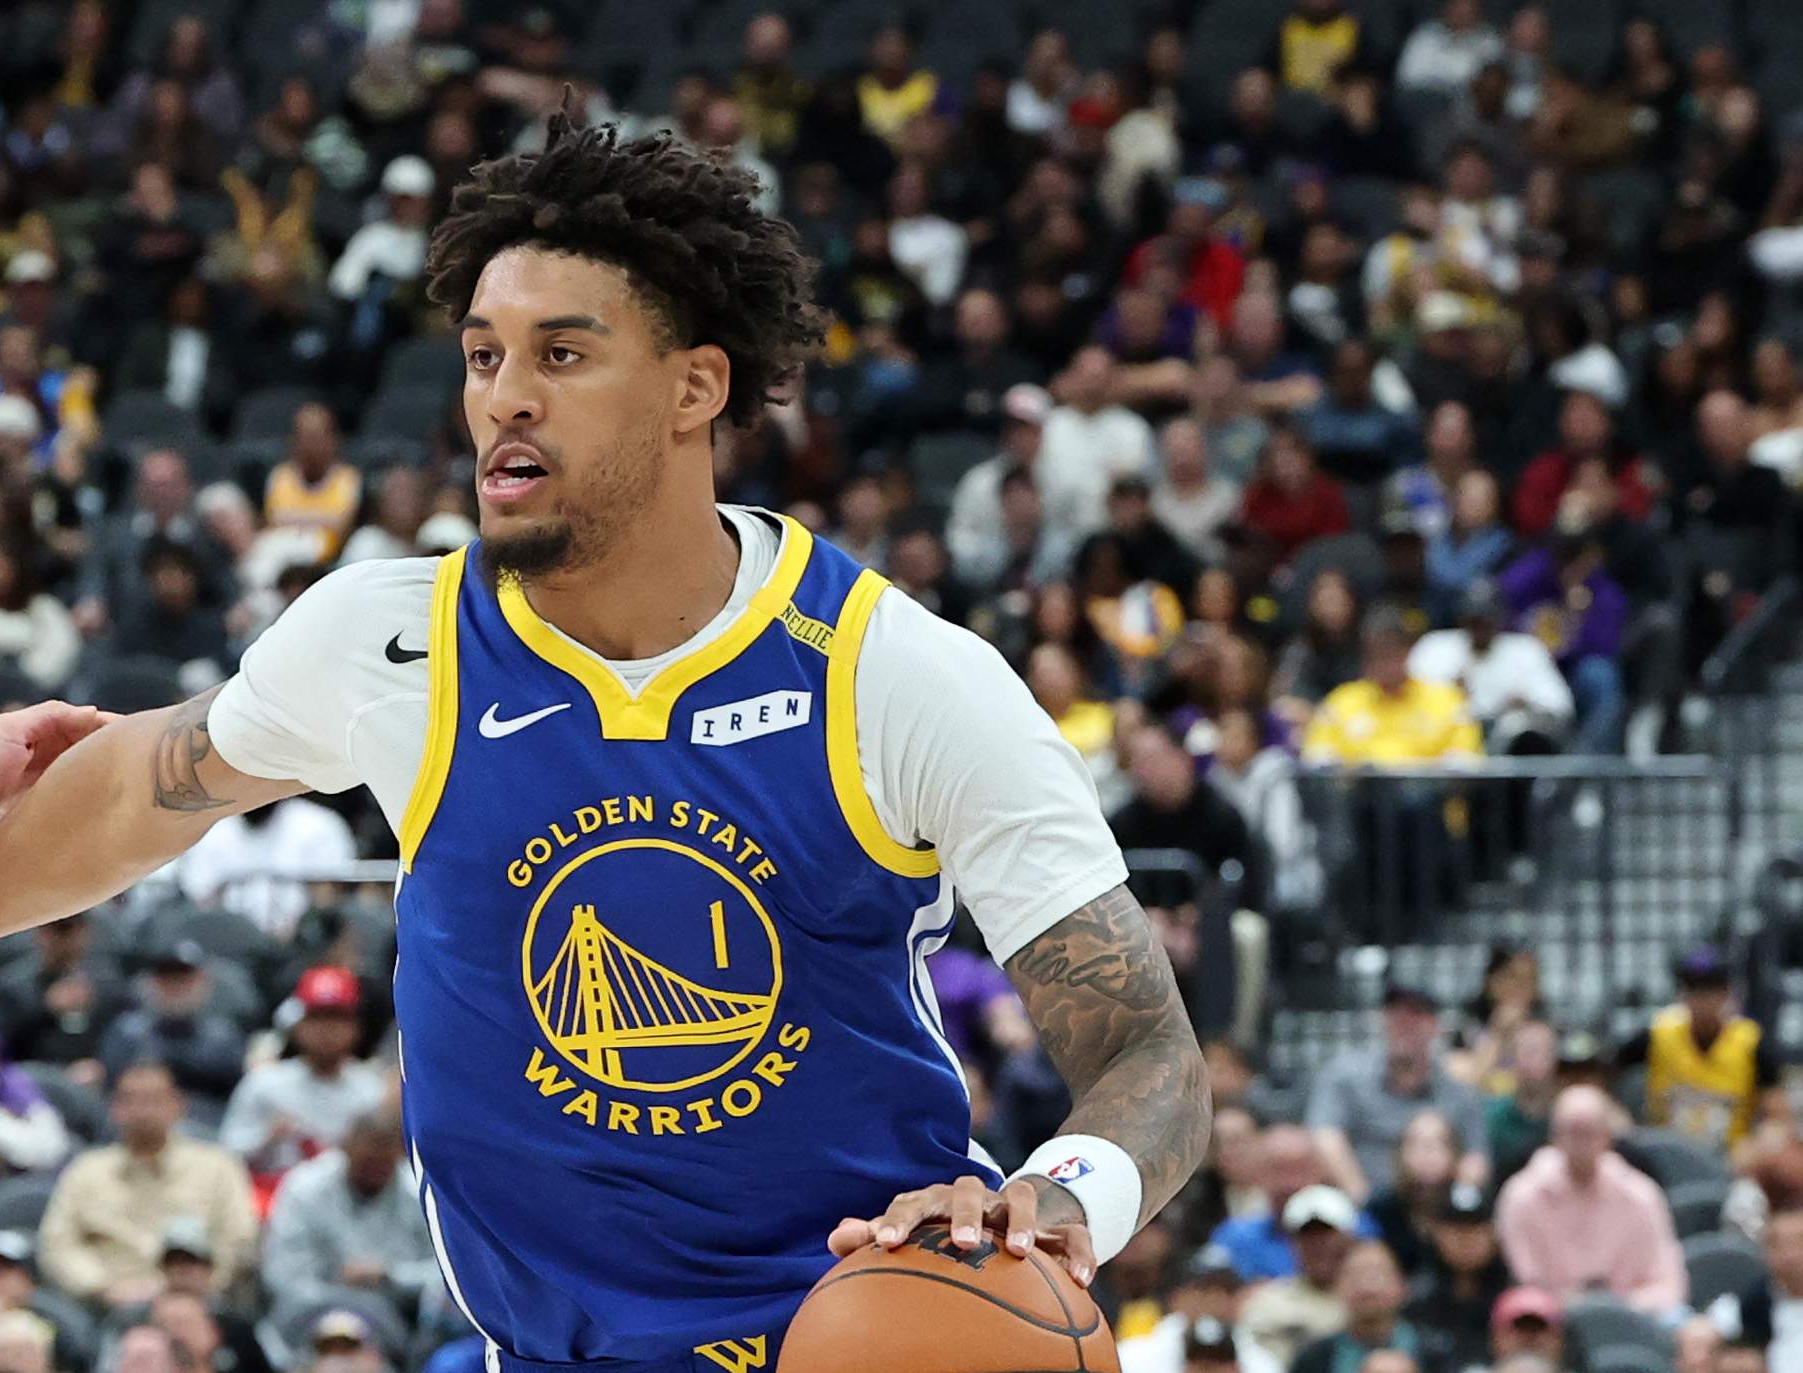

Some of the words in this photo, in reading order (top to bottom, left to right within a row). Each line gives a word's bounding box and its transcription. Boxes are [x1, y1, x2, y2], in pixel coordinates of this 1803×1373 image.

[780, 604, 834, 650] NELLIE
[703, 698, 799, 738] IREN
[507, 796, 654, 888] GOLDEN
[669, 801, 778, 885] STATE
[709, 900, 730, 969] 1
[524, 1022, 812, 1136] WARRIORS
